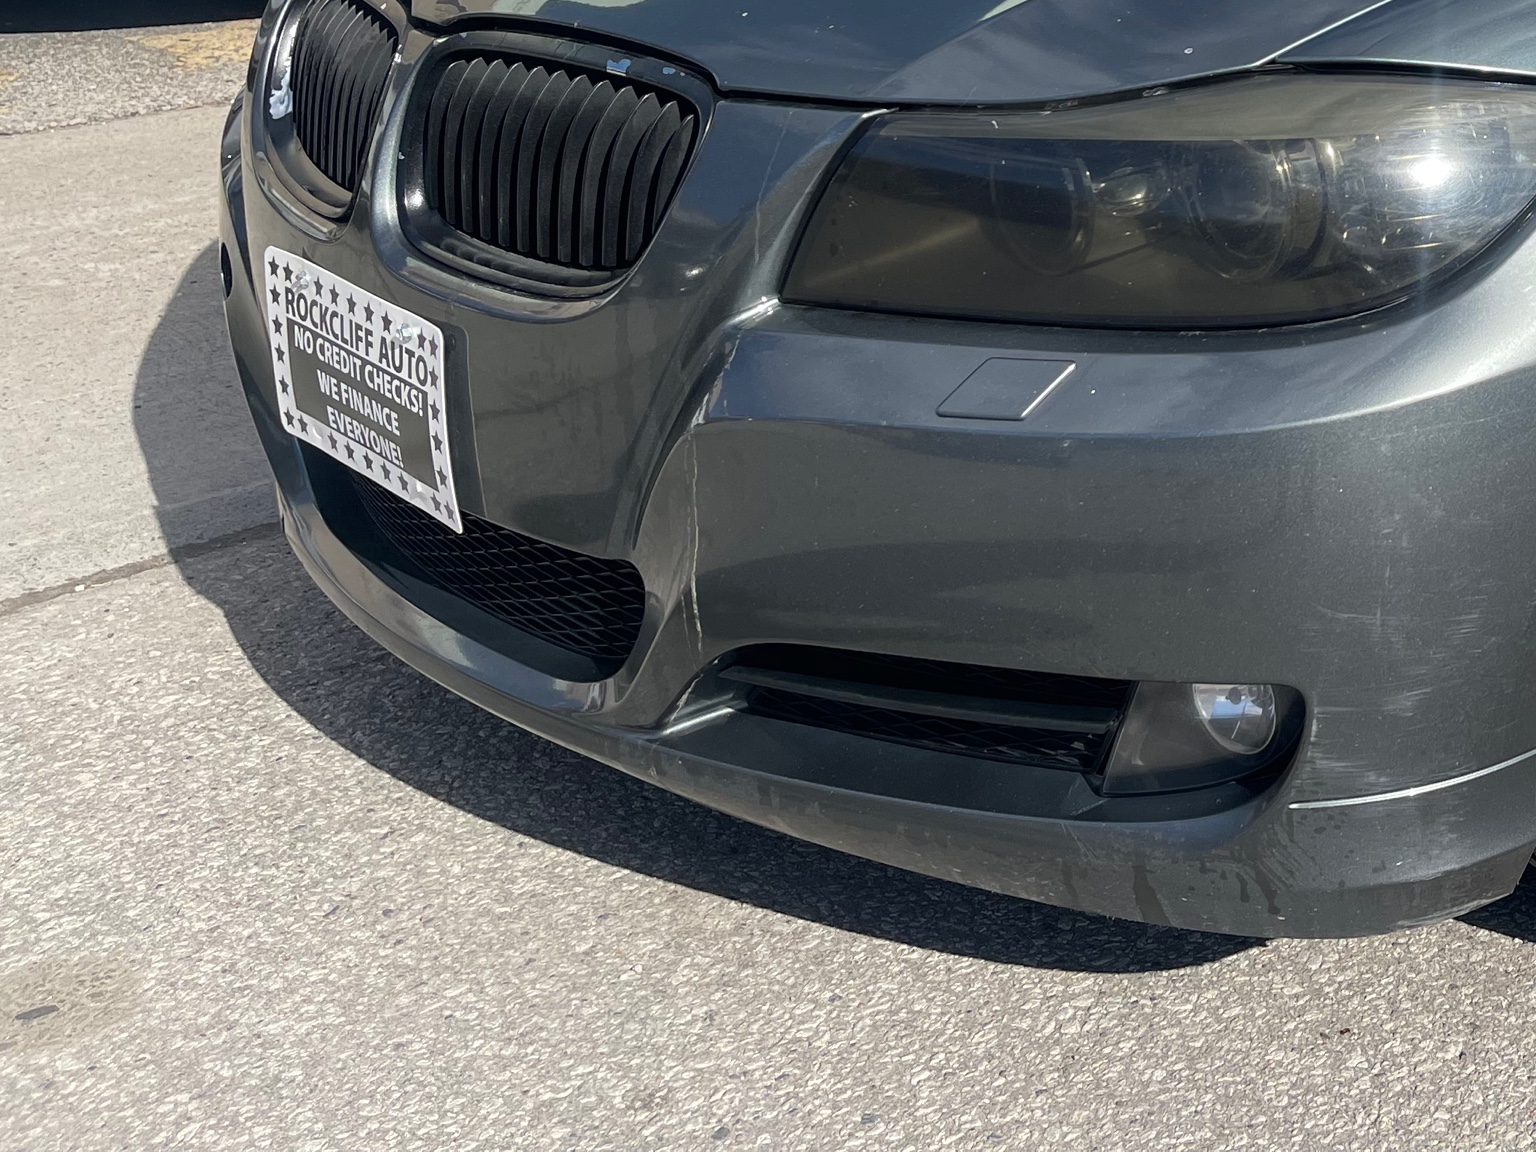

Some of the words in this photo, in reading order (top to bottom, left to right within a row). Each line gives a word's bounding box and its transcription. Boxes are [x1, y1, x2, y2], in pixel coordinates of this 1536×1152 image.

[285, 286, 374, 357] ROCKCLIFF
[379, 336, 428, 387] AUTO
[294, 325, 313, 354] NO
[316, 337, 362, 381] CREDIT
[364, 364, 423, 417] CHECKS!
[317, 369, 340, 401] WE
[340, 383, 400, 436] FINANCE
[327, 405, 404, 468] EVERYONE!
